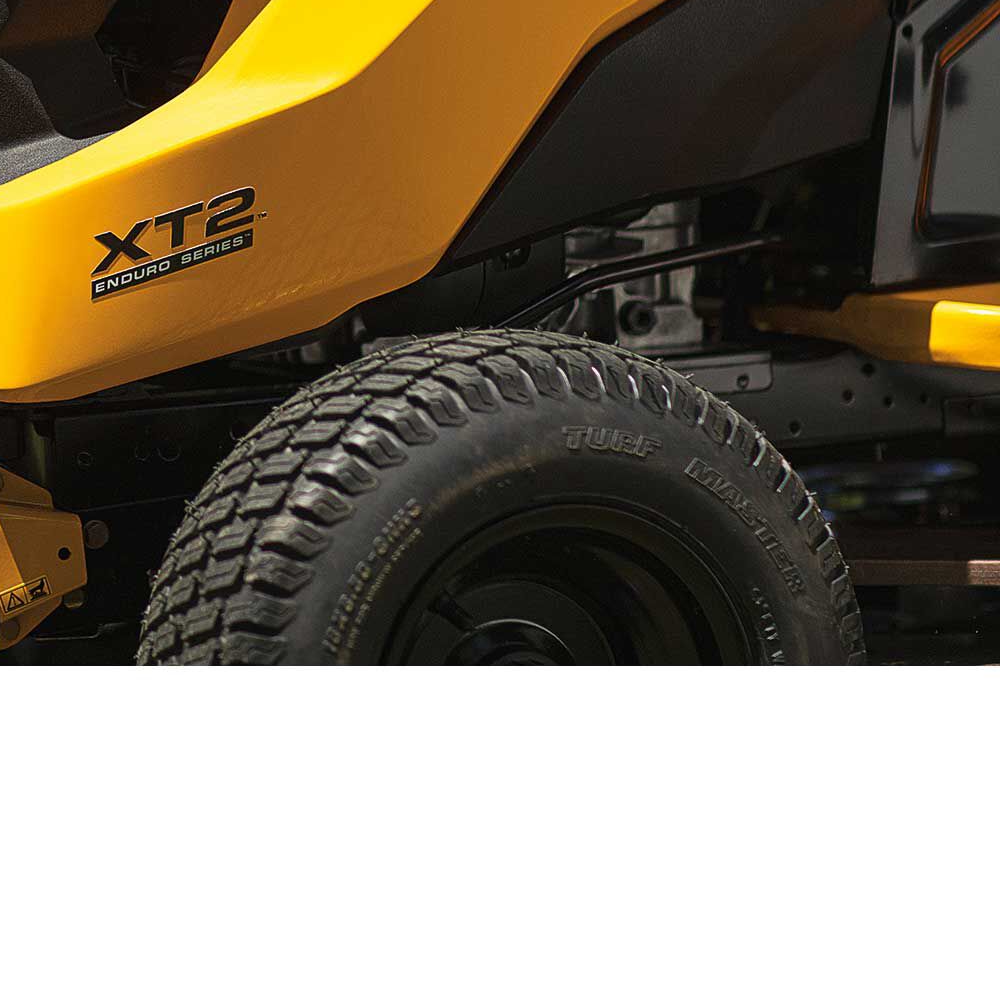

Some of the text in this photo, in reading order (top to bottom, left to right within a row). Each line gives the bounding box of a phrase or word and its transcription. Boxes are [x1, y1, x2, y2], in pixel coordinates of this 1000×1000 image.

[91, 186, 256, 276] XT2
[95, 235, 243, 293] ENDURO SERIES
[562, 425, 804, 594] TURF MASTER
